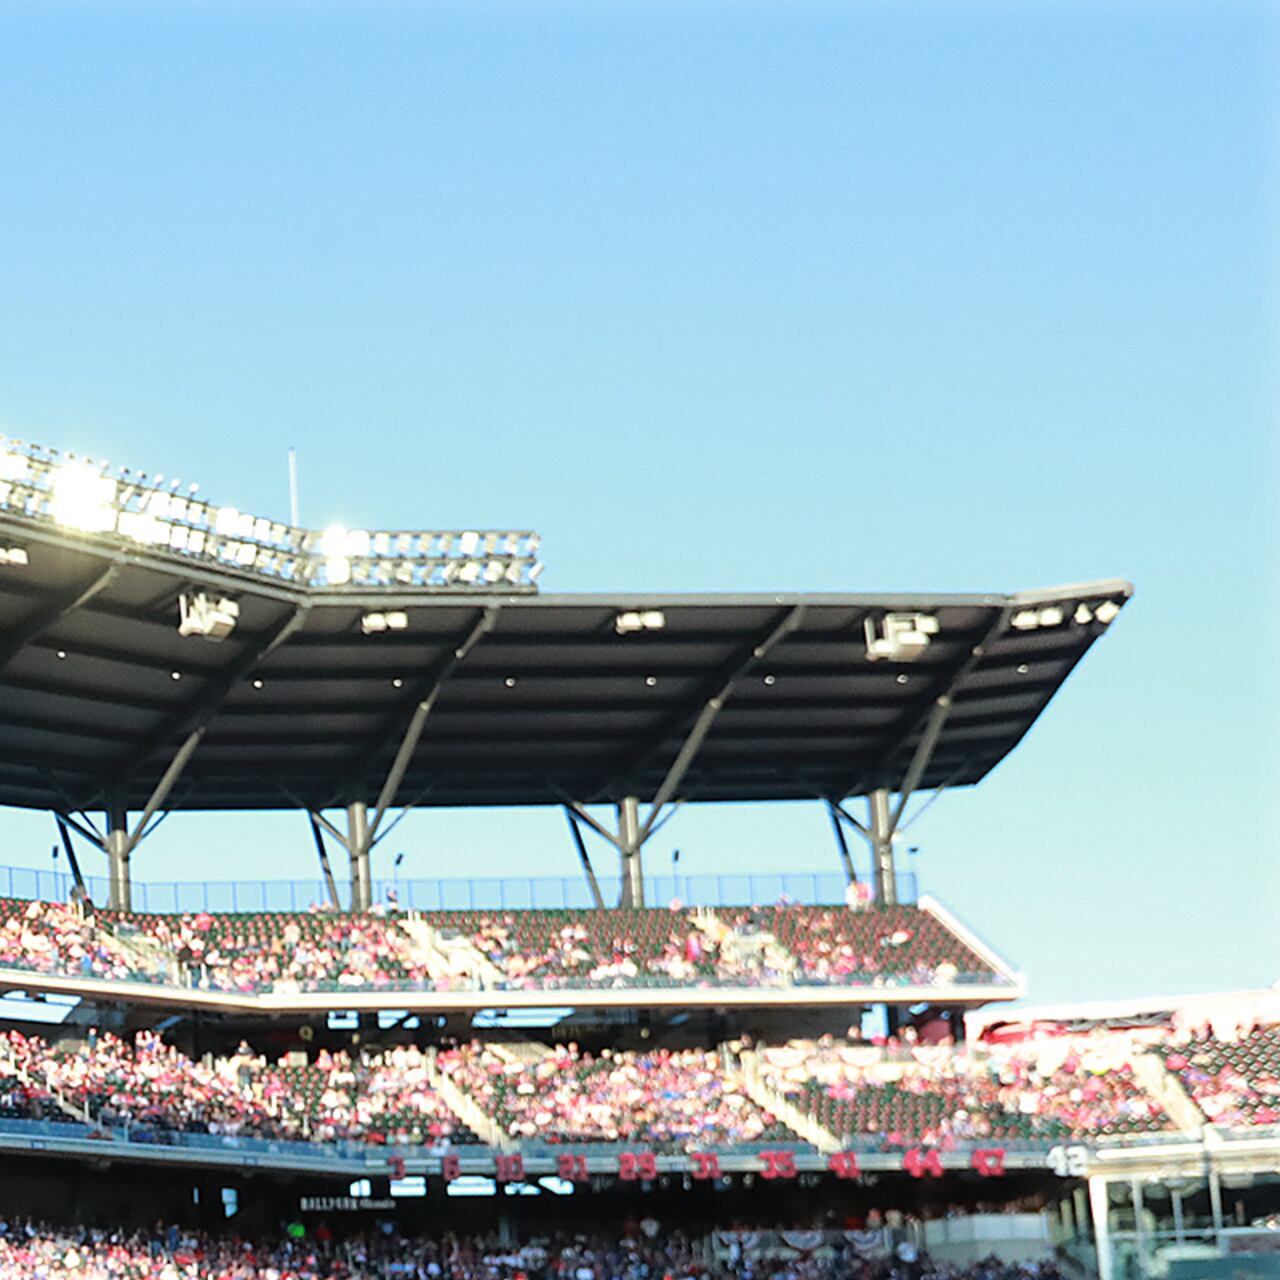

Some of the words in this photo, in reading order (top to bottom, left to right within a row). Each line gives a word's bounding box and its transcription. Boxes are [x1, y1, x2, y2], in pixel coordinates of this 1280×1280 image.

[558, 1154, 588, 1181] 21
[619, 1153, 656, 1180] 29
[692, 1152, 722, 1179] 31
[1046, 1145, 1088, 1176] 42
